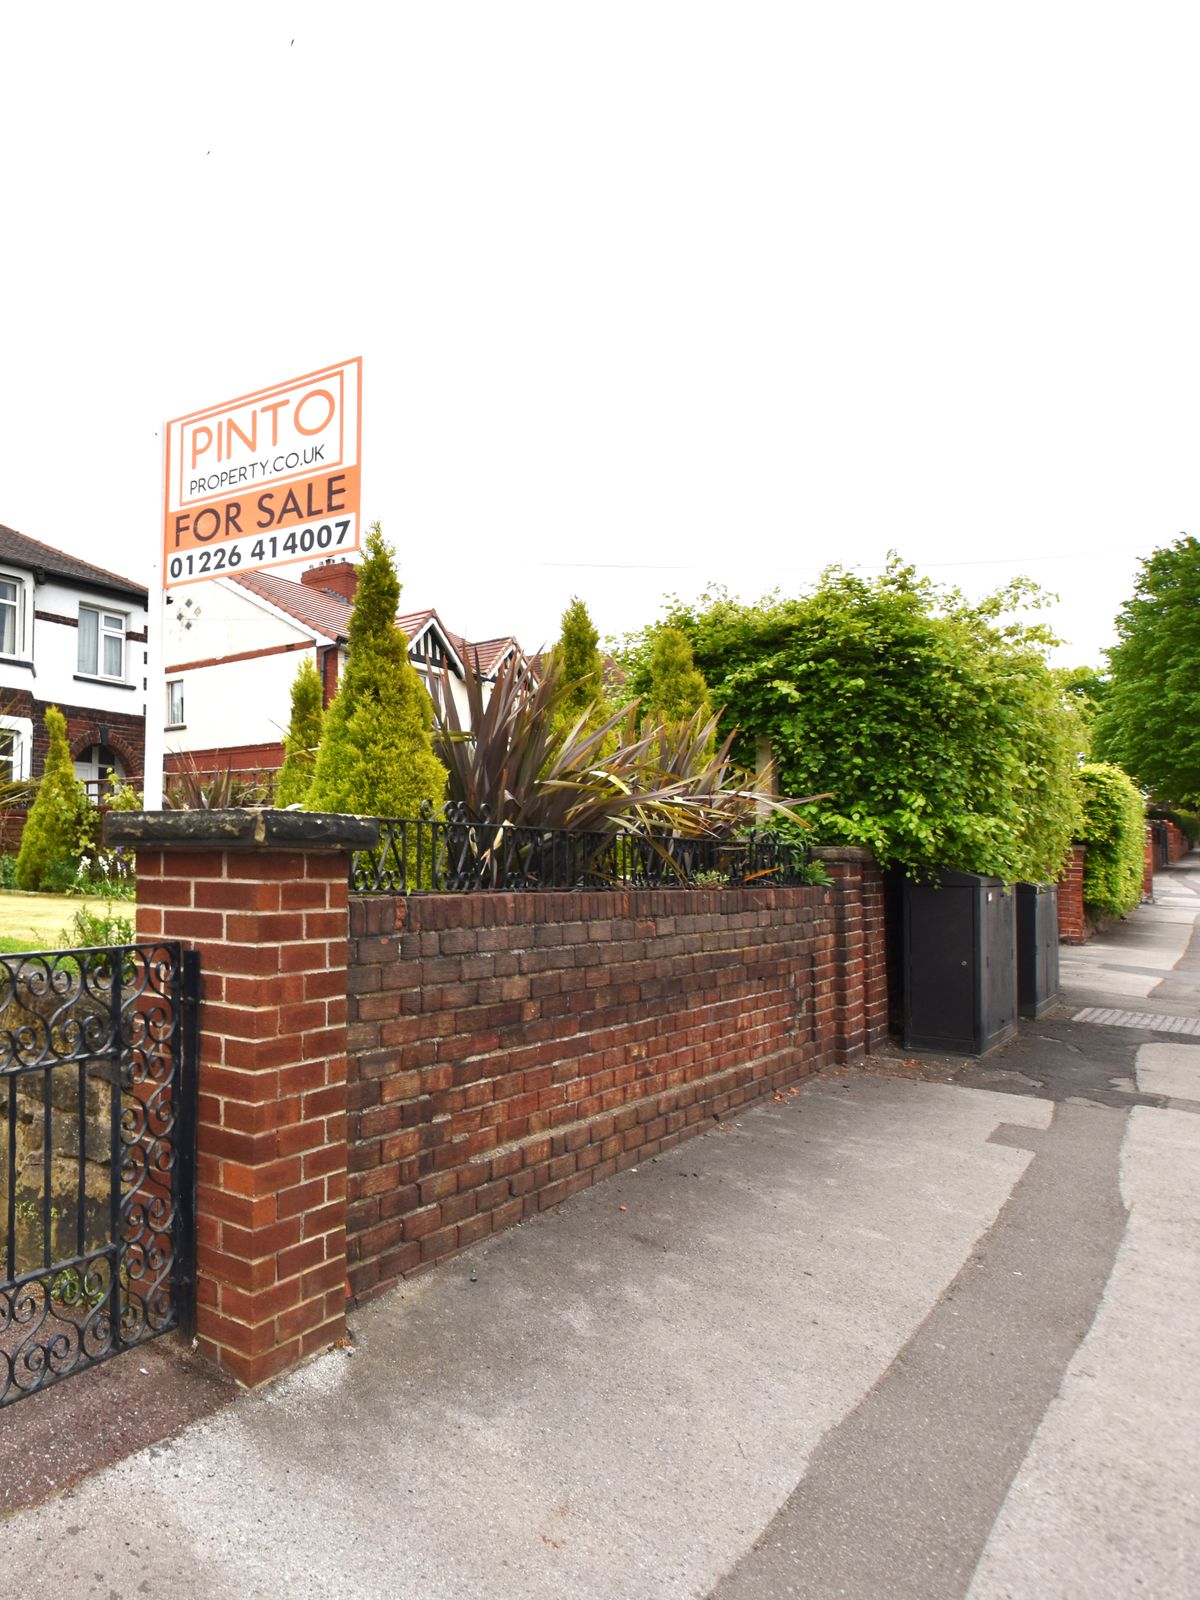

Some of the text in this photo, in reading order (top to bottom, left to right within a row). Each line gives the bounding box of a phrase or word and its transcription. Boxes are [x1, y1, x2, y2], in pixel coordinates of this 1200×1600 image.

[191, 389, 336, 470] PINTO
[190, 444, 325, 495] PROPERTY.CO.UK
[175, 474, 347, 547] FOR SALE
[170, 520, 351, 578] 01226 414007
